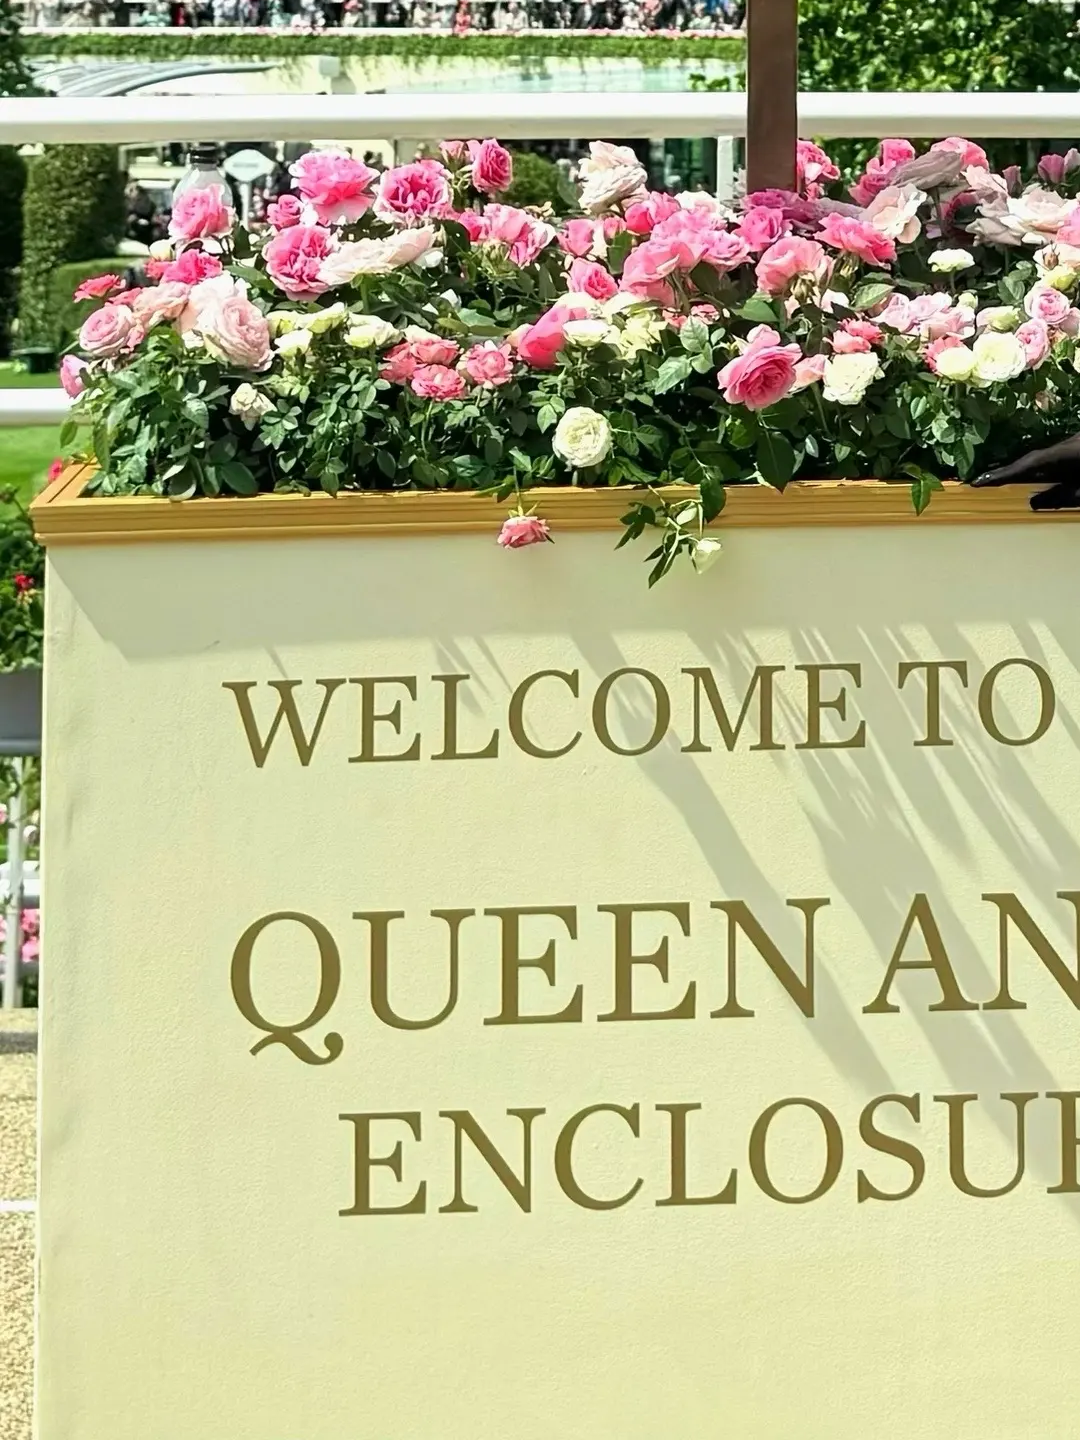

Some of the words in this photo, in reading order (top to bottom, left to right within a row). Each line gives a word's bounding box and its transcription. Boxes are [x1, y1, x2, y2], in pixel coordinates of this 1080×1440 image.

[222, 663, 868, 768] WELCOME
[898, 657, 1057, 747] TO
[230, 897, 832, 1066] QUEEN
